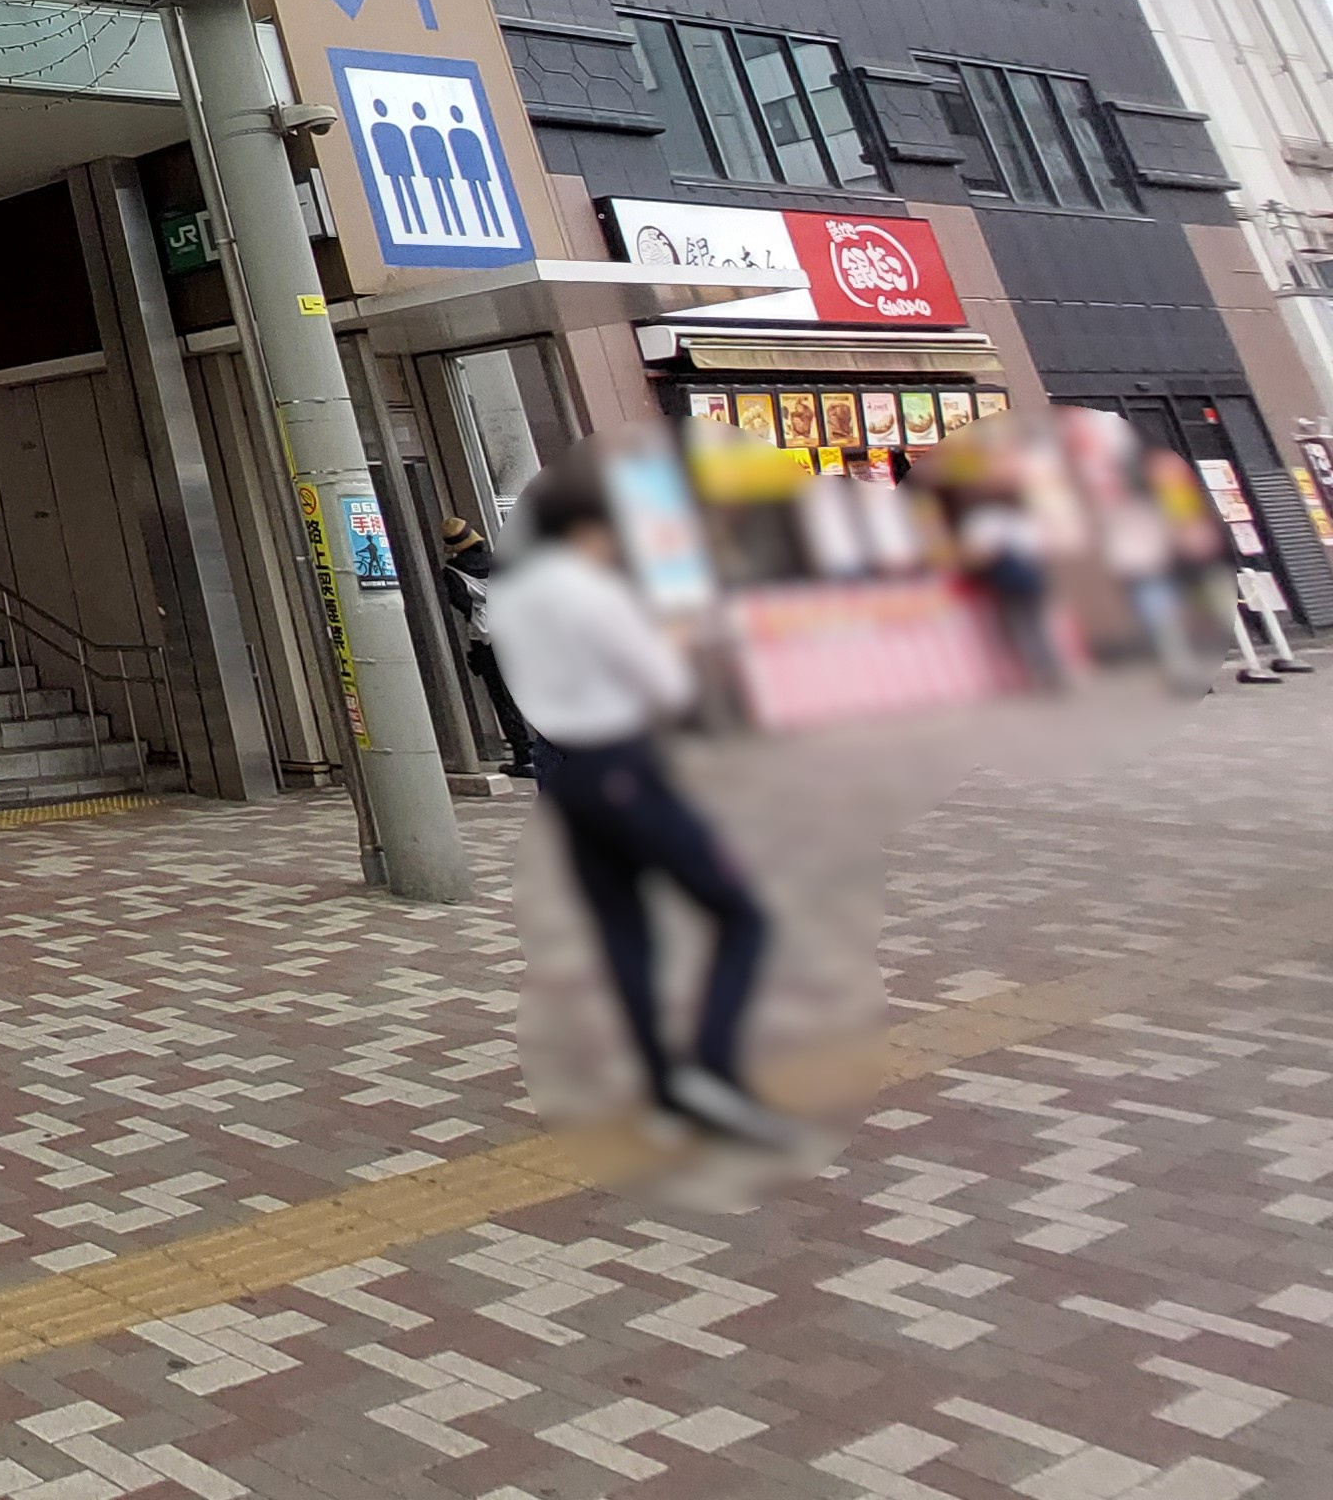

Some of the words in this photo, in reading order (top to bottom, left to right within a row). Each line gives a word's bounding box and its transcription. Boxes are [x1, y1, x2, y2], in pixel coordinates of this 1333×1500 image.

[168, 224, 199, 248] JR
[841, 240, 908, 292] 銀だこ
[300, 298, 326, 311] L-
